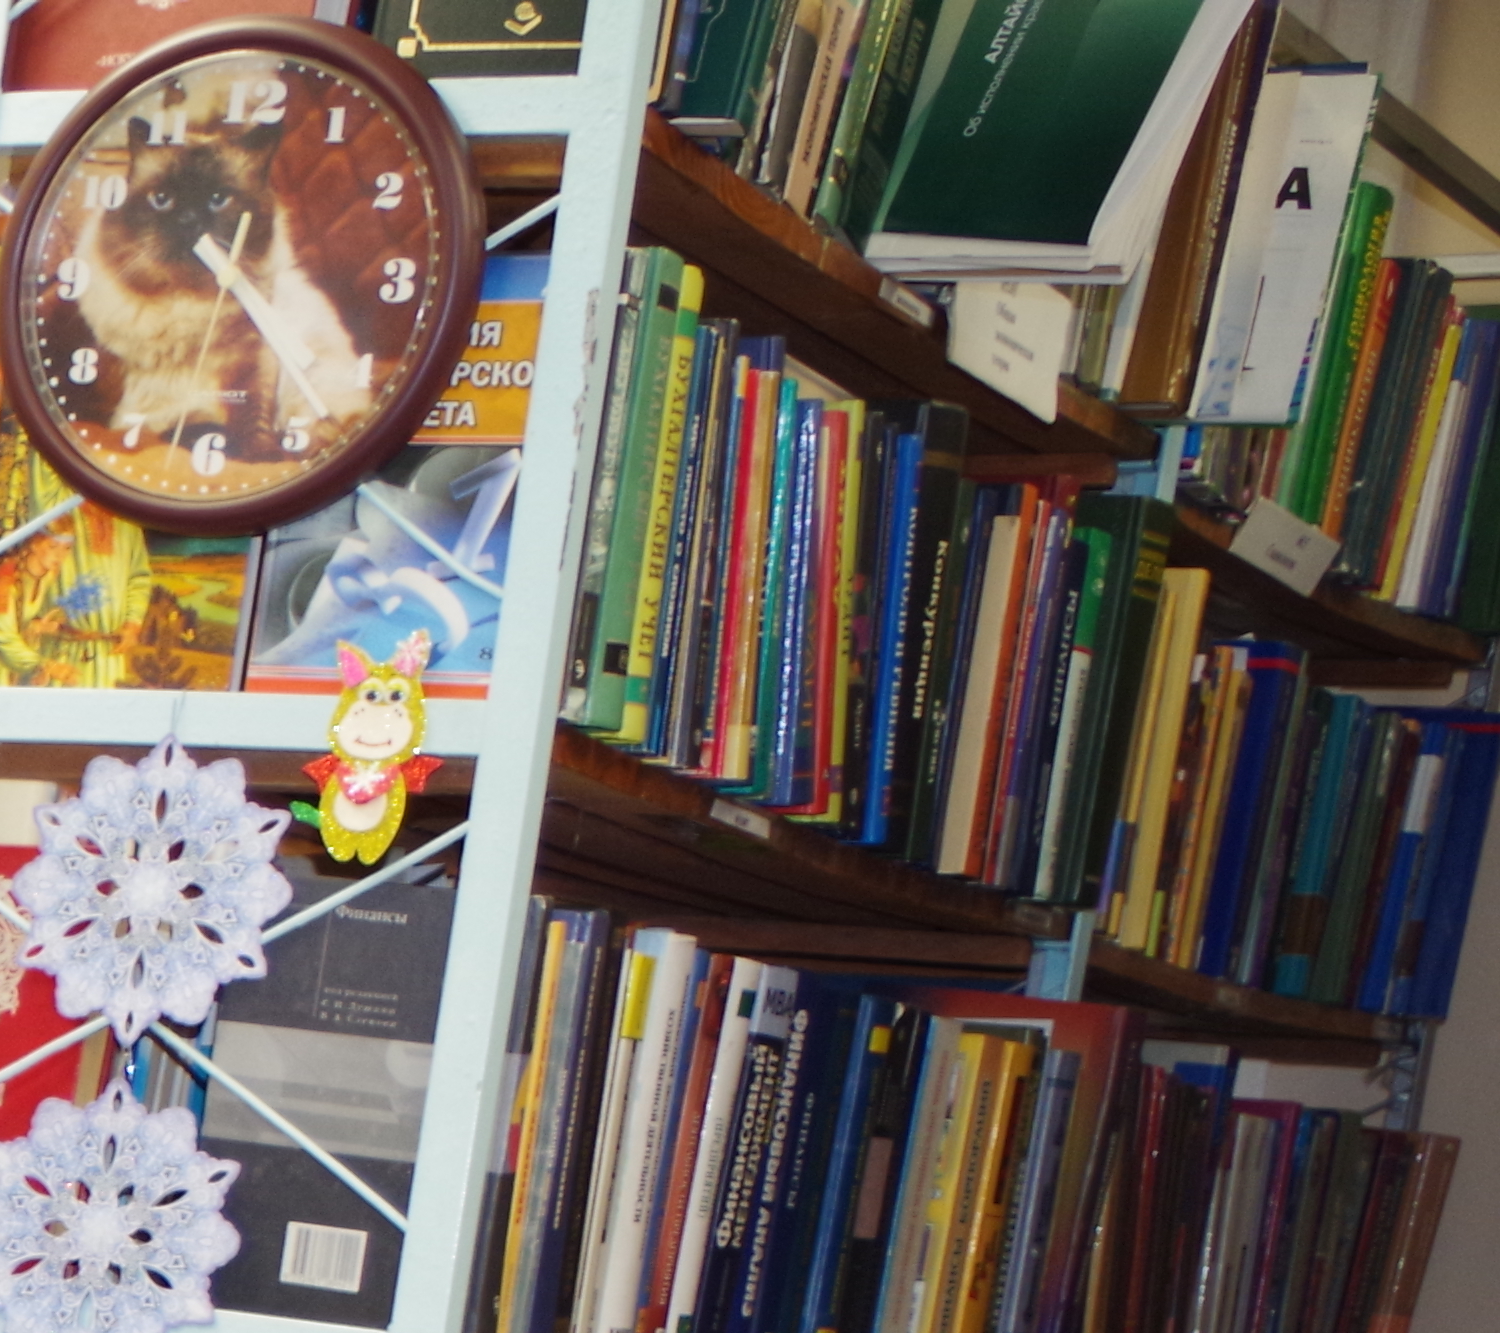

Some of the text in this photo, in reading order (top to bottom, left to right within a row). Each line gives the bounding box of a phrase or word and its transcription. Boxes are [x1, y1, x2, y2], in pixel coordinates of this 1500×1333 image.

[223, 79, 288, 124] 12
[962, 28, 1027, 140] Об исполнении
[147, 110, 187, 146] 11
[324, 106, 346, 143] 1
[83, 175, 128, 212] 10
[372, 171, 404, 211] 2
[56, 256, 91, 301] 9
[378, 256, 417, 304] 3
[68, 347, 99, 386] 8
[352, 353, 374, 389] 4
[122, 412, 147, 450] 7
[282, 416, 311, 453] 5
[191, 433, 227, 477] 6
[634, 353, 693, 660] БУХГАЛТЕРСКИЙ УЧЕТ
[335, 904, 408, 925] Финансы
[707, 1041, 773, 1249] Финансовый
[737, 1006, 811, 1320] ФИНАНСОВЫЙ АНАЛИЗ
